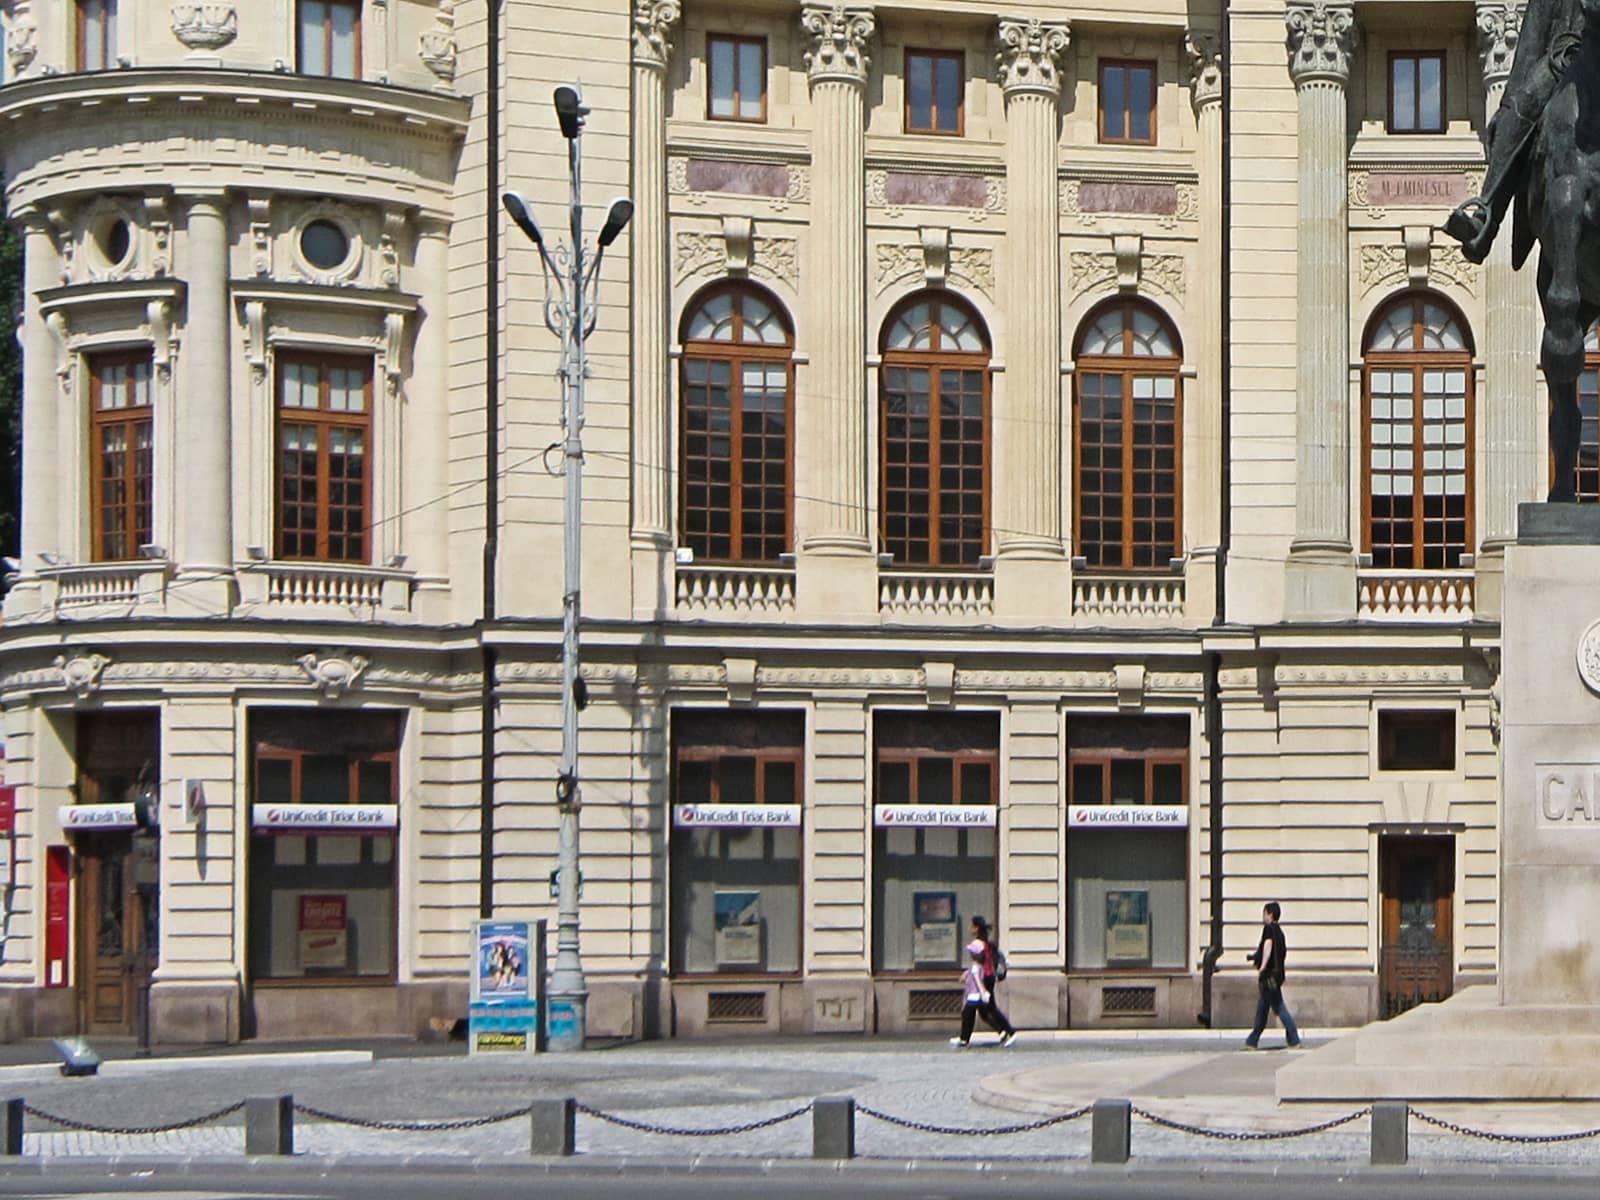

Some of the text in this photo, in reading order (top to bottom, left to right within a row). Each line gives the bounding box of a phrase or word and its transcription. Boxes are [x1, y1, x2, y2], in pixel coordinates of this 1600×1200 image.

[357, 809, 384, 822] Bank
[766, 811, 791, 822] Bank
[963, 810, 987, 822] Bank
[1155, 810, 1180, 822] Bank
